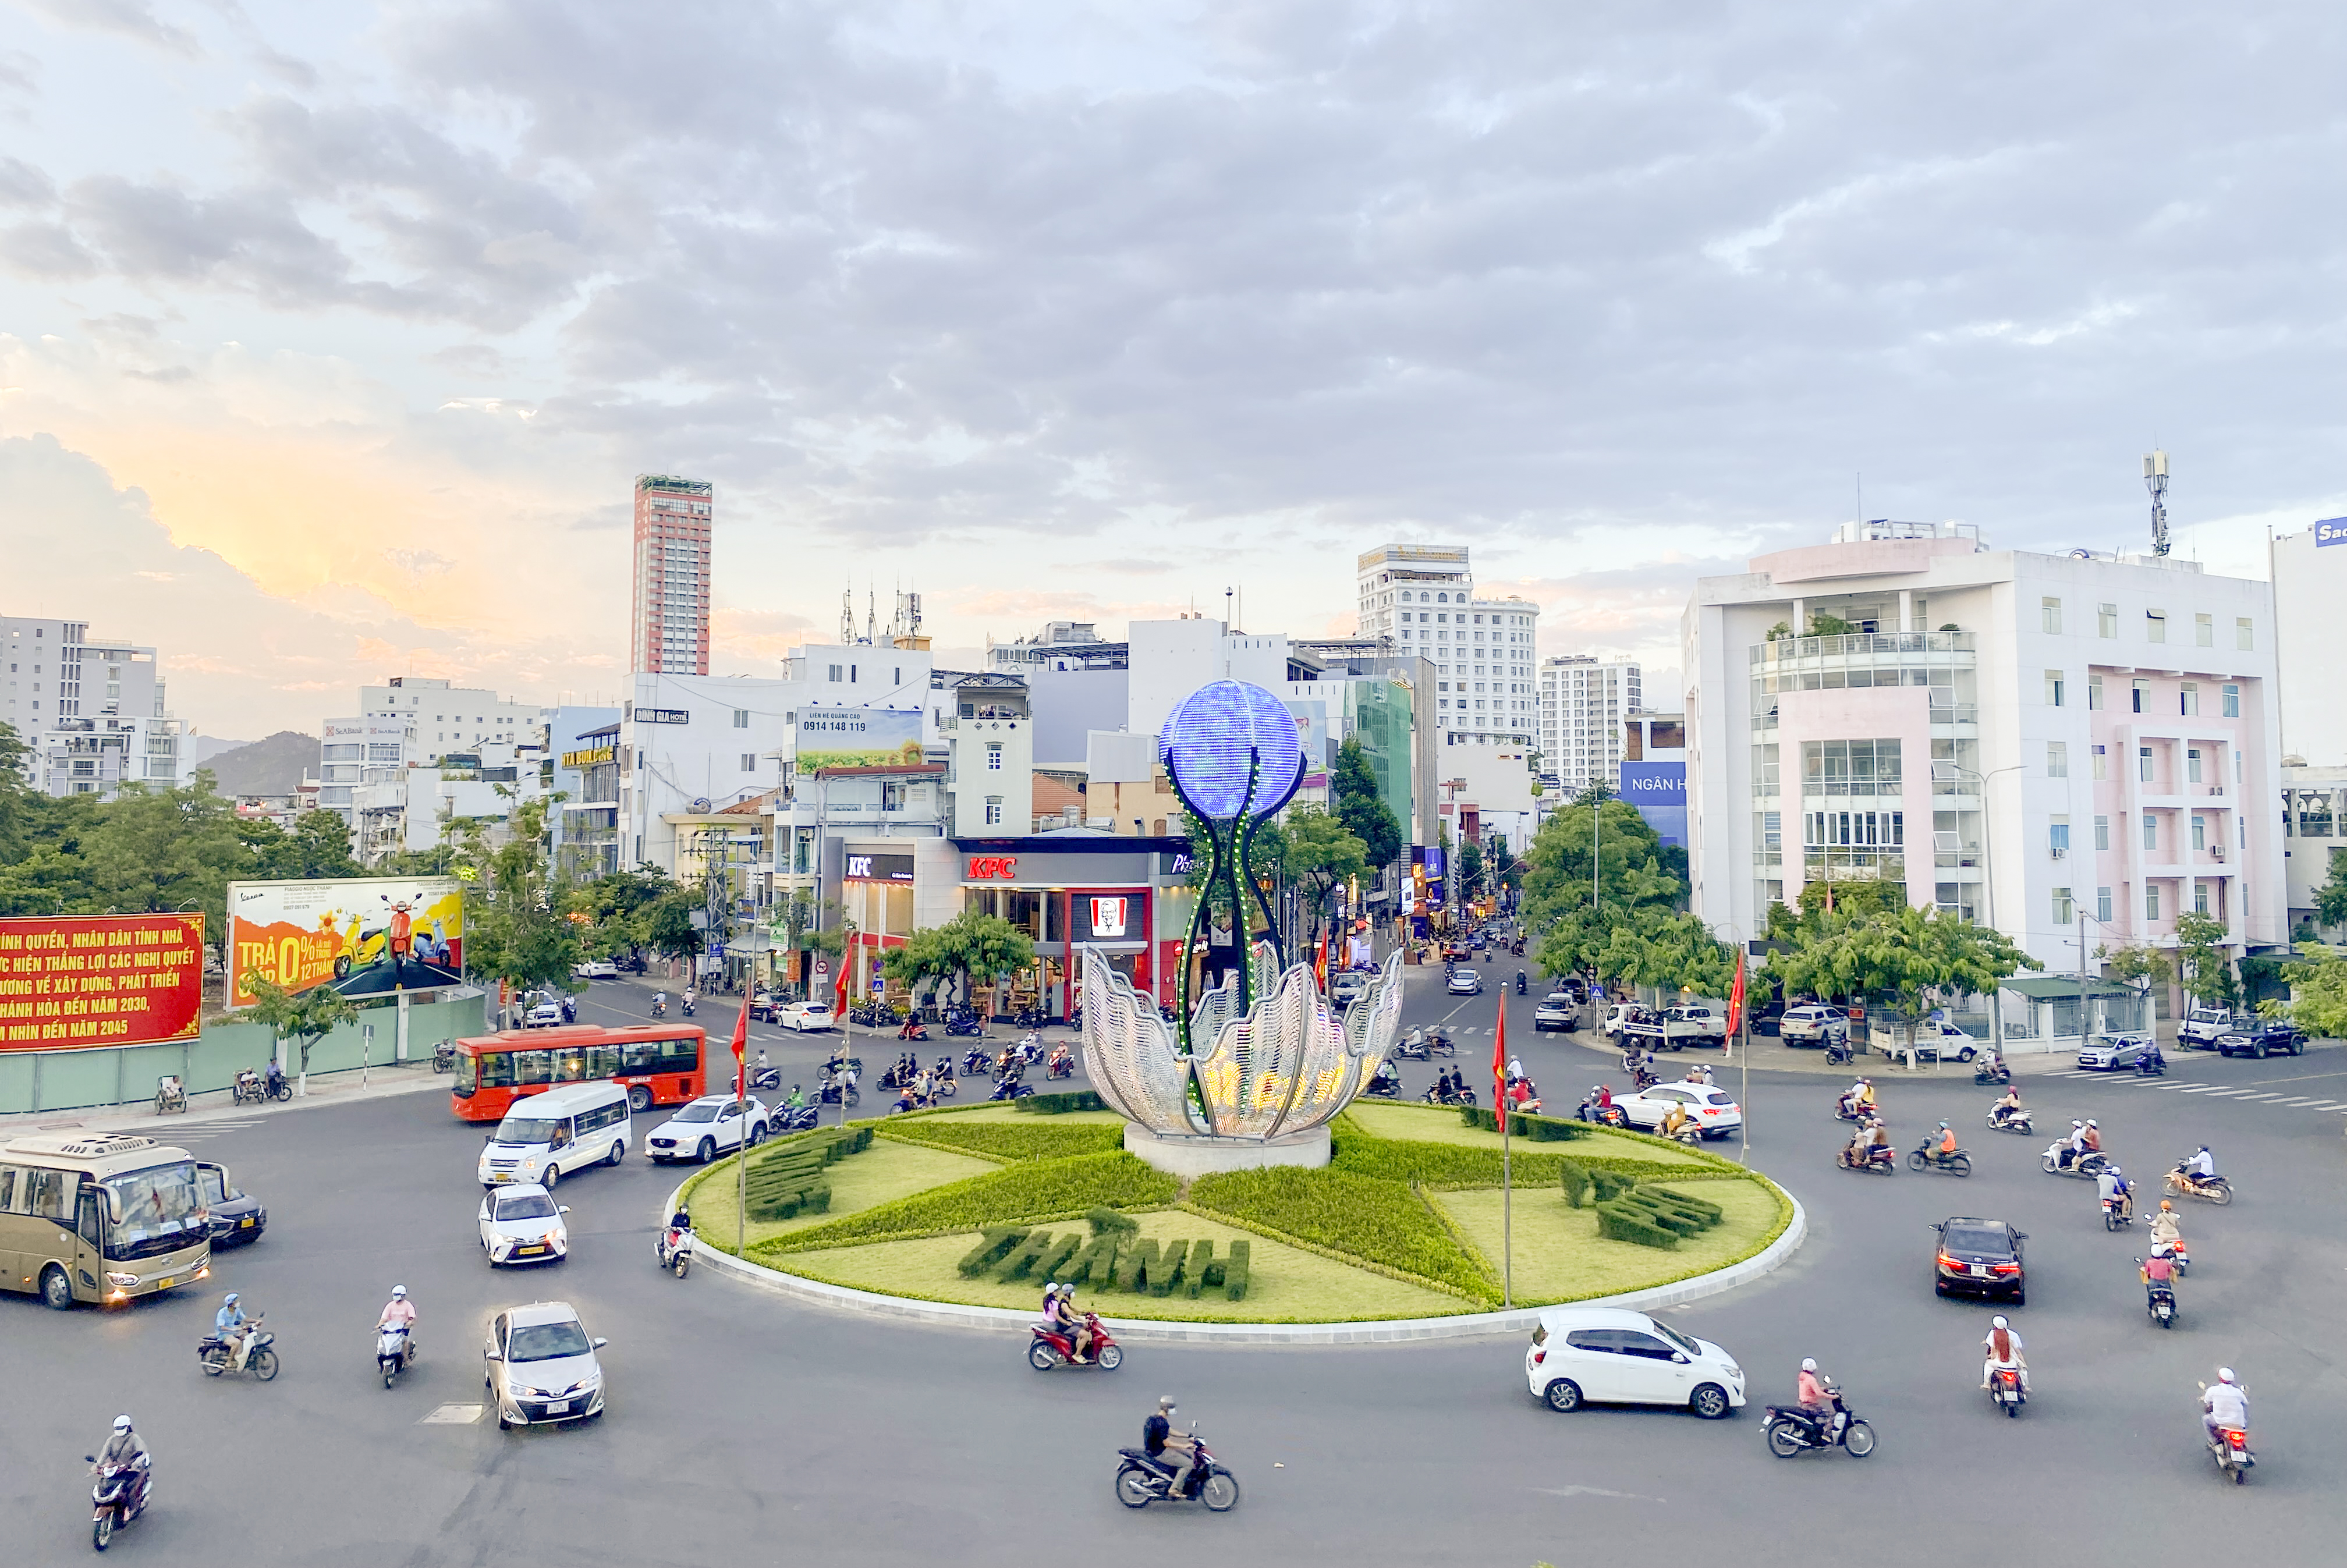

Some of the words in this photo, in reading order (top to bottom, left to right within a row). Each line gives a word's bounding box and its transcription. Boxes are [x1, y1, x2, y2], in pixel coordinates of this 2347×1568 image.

[656, 710, 670, 722] GIA
[670, 713, 688, 721] HOTEL
[335, 726, 363, 735] SeABank
[804, 721, 826, 730] 0914
[829, 722, 846, 731] 148
[849, 722, 866, 732] 119
[576, 746, 614, 765] BUILDING
[1632, 775, 1674, 790] NGÂN
[848, 856, 872, 877] KFC
[967, 857, 1016, 879] KFC
[240, 892, 264, 902] Vespa
[0, 931, 22, 950] ÍNH
[26, 929, 69, 951] QUYỀN,
[72, 930, 105, 948] NHÂN
[108, 928, 132, 947] DÂN
[134, 925, 159, 946] TỈNH
[161, 926, 183, 945] NHÀ
[13, 953, 42, 975] HIỆN
[45, 950, 85, 971] THẮNG
[87, 953, 106, 973] LỢI
[109, 950, 132, 969] CÁC
[134, 952, 160, 970] NGHỊ
[163, 945, 195, 967] QUYẾT
[238, 935, 276, 967] TRẢ
[315, 949, 331, 959] TRONG
[36, 974, 51, 995] VỀ
[54, 975, 78, 994] XÂY
[80, 975, 116, 995] DỰNG,
[119, 971, 147, 990] PHÁT
[150, 967, 180, 988] TRIỂN
[301, 963, 311, 981] 12
[0, 999, 33, 1018] HÁNH
[36, 998, 61, 1017] HÒA
[63, 995, 88, 1016] ĐẾN
[91, 995, 118, 1014] NĂM
[120, 996, 150, 1013] 2030,
[9, 1021, 39, 1041] NHÌN
[42, 1019, 67, 1040] ĐẾN
[70, 1019, 98, 1038] NĂM
[100, 1019, 128, 1036] 2045
